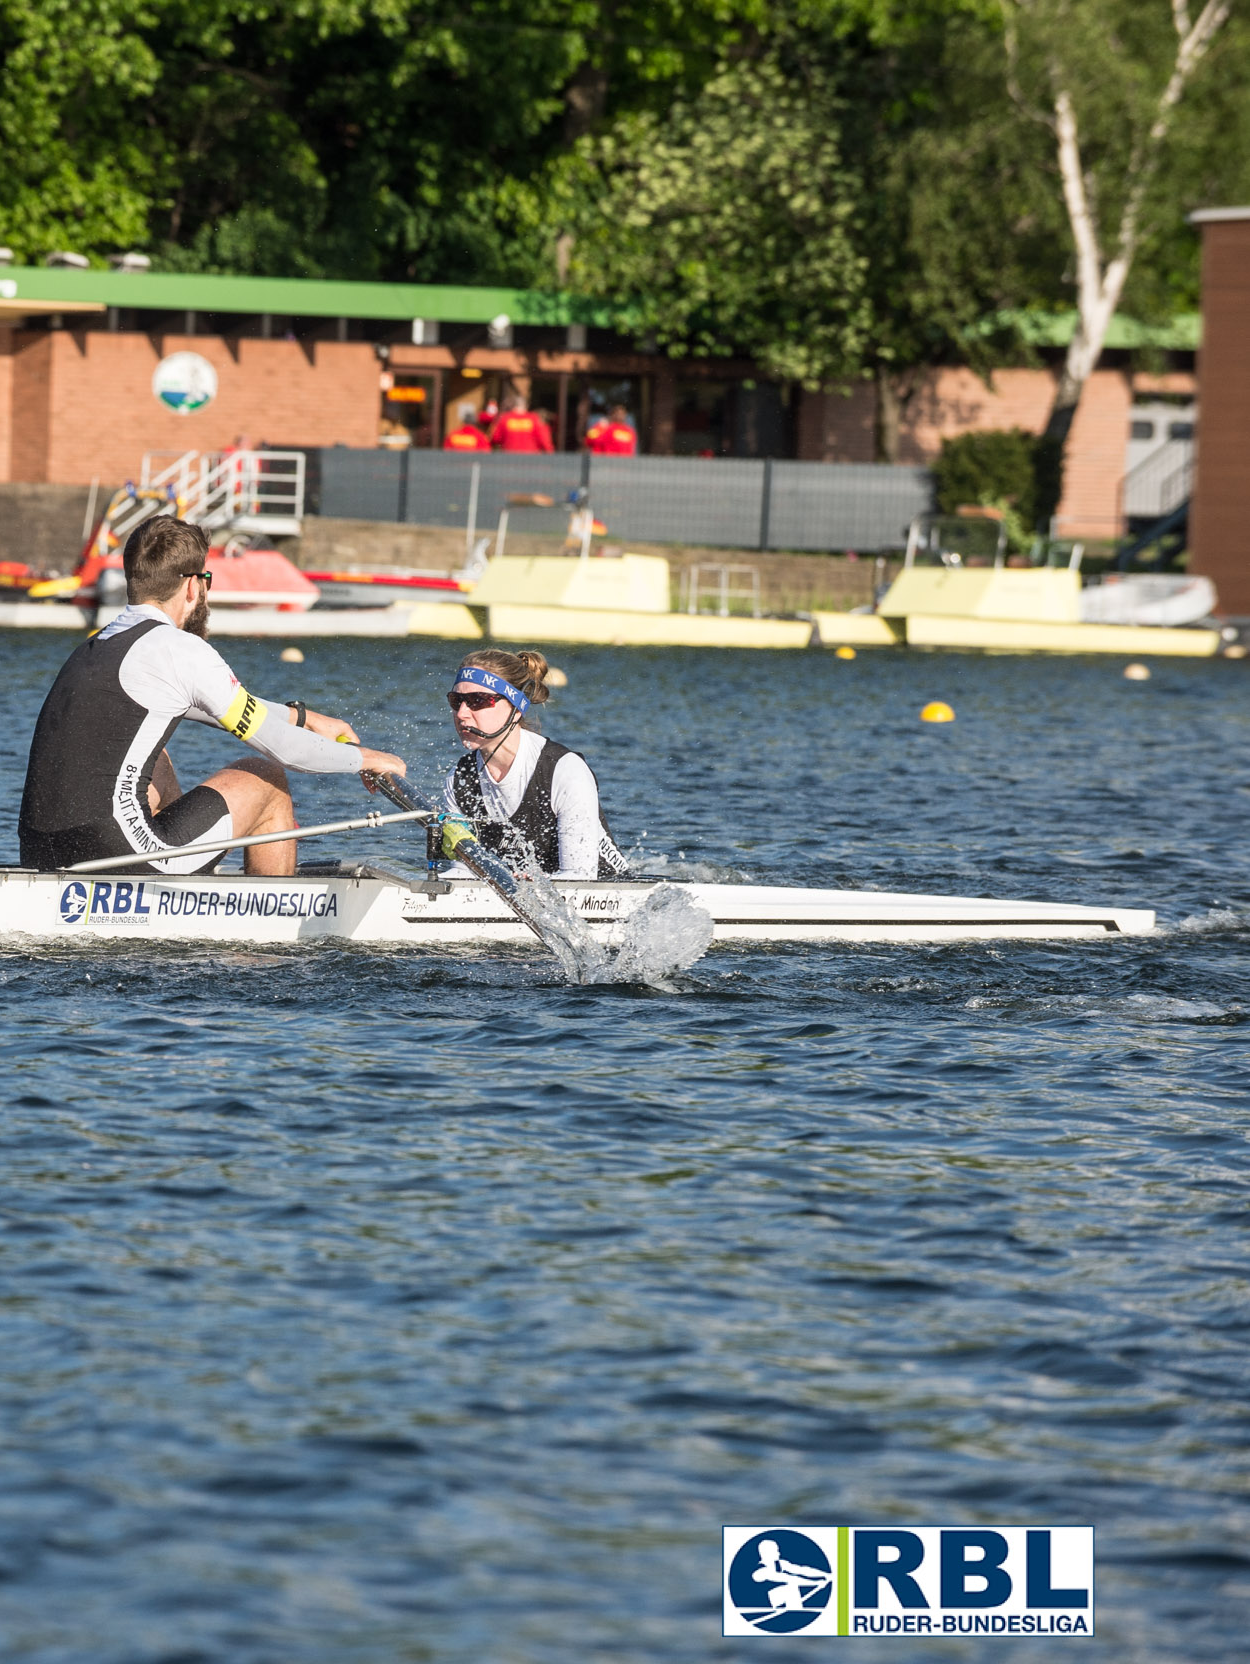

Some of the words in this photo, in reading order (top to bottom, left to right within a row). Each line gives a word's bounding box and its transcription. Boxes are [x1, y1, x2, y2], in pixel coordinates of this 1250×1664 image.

[461, 669, 476, 680] NK
[482, 673, 499, 688] NK
[504, 684, 519, 701] NK
[91, 882, 151, 914] RBL
[157, 891, 338, 917] RUDER-BUNDESLIGA
[88, 916, 149, 924] RUDER-BUNDESLIGA
